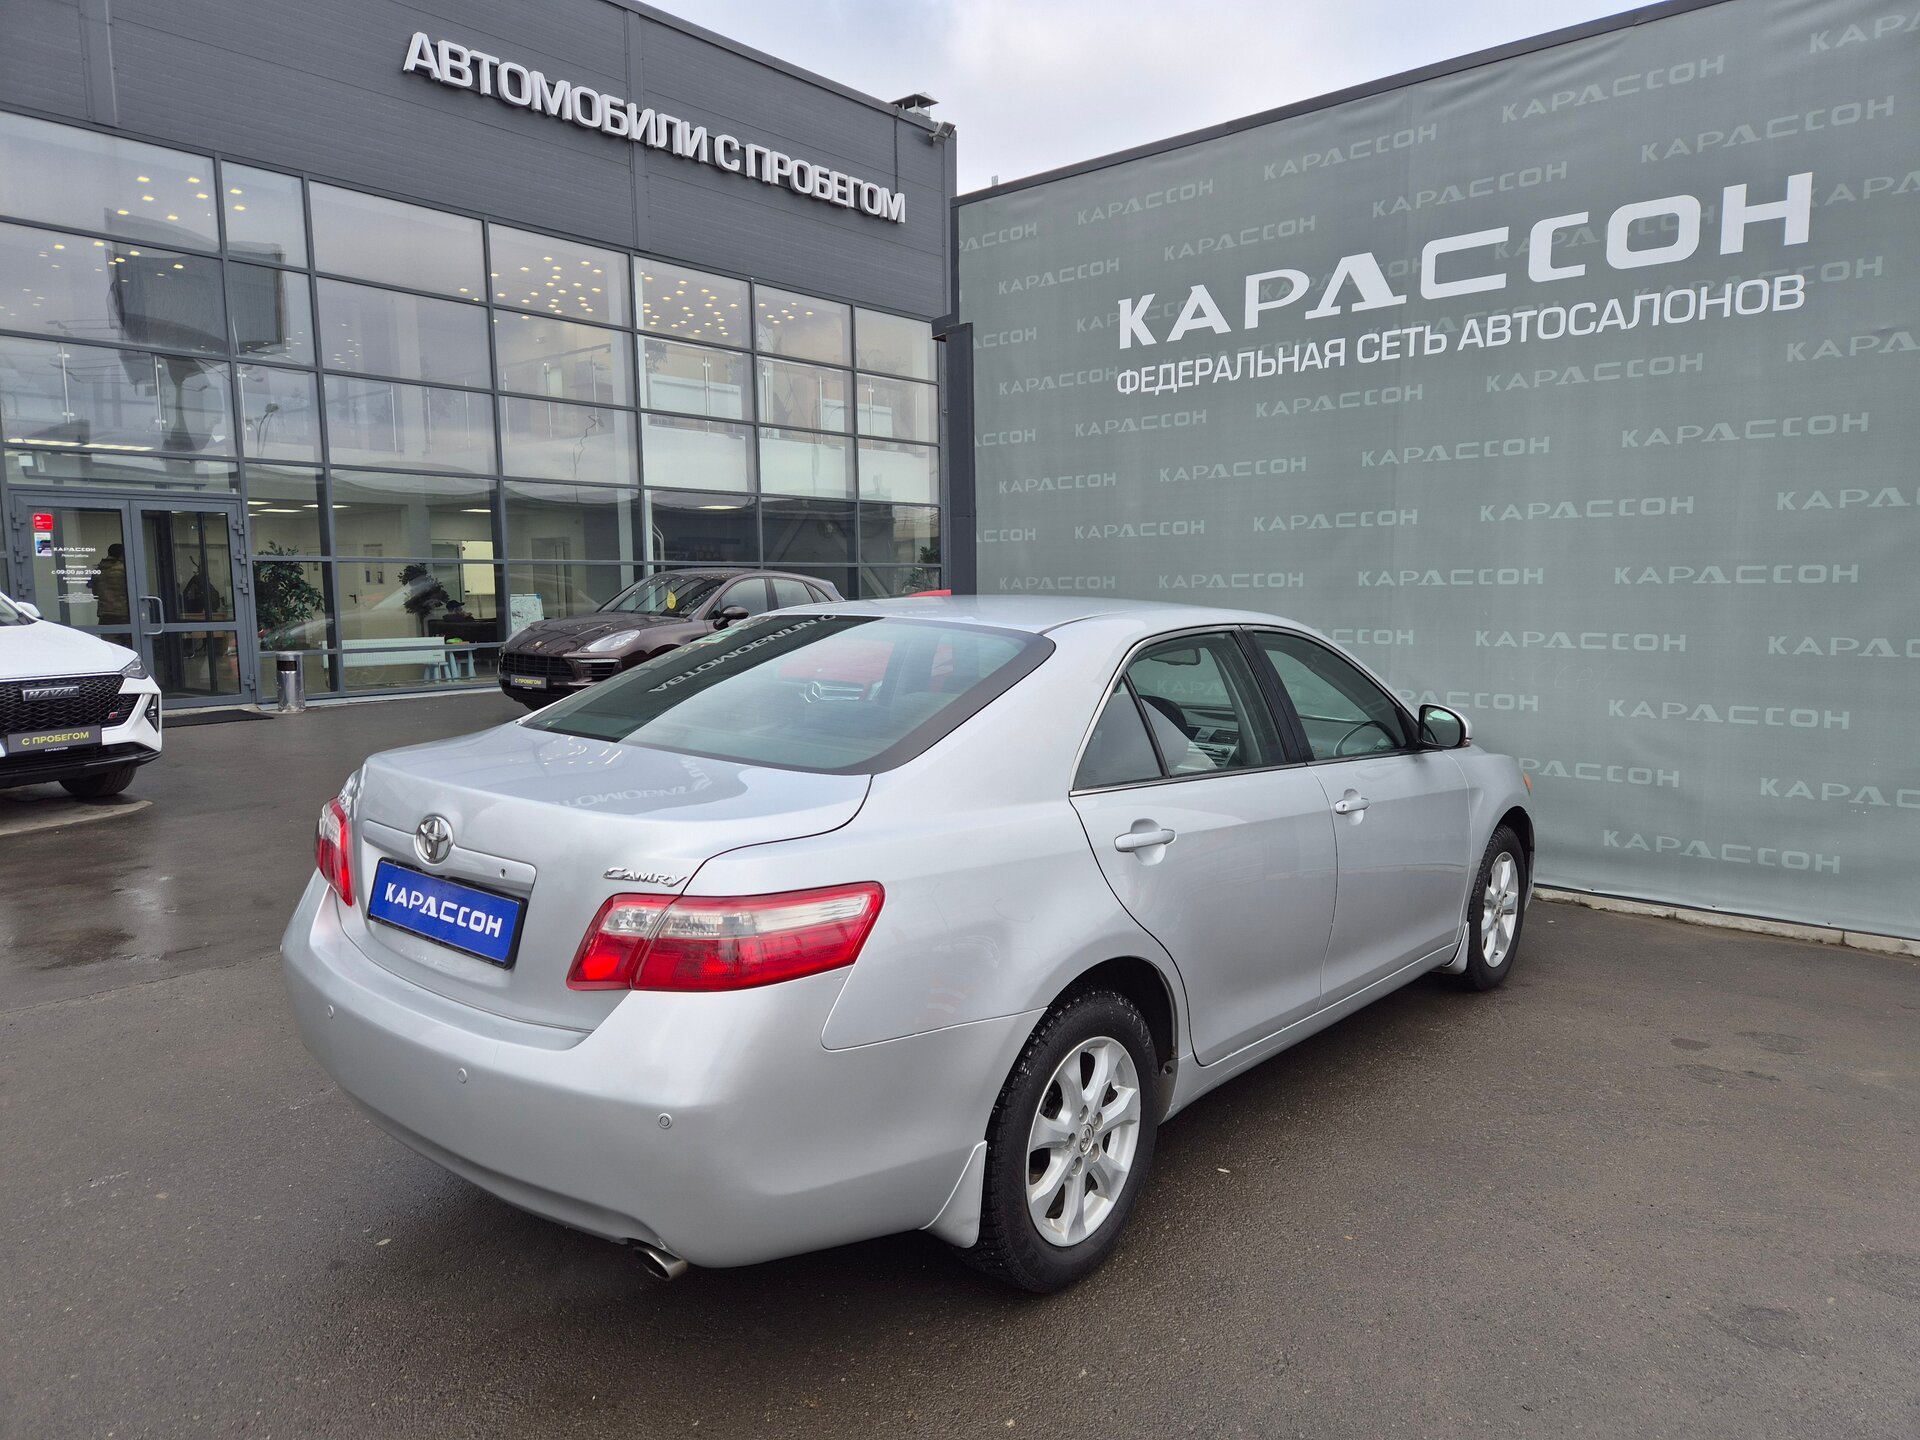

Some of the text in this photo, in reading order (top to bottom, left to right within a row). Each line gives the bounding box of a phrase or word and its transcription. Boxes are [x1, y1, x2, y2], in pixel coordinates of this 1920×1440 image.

[1502, 54, 1725, 123] КАРАССОН
[403, 31, 905, 224] АВТОМОБИЛИ С ПРОБЕГОМ
[1641, 95, 1895, 163] КАРАССОН
[1263, 123, 1437, 181] КАРАССОН
[1078, 178, 1214, 226] КАРАССОН
[1372, 160, 1567, 218] КАРАССОН
[1164, 214, 1317, 262] КАРАССОН
[999, 257, 1120, 295] КАРАССОН
[1118, 172, 1812, 349] КАРАССОН
[1117, 274, 1806, 395] ФЕДЕРАЛЬНАЯ СЕТЬ АВТОСАЛОНОВ
[1486, 353, 1703, 393] КАРАССОН
[1256, 384, 1423, 418] КАРАССОН
[1075, 409, 1207, 437] КАРАССОН
[1621, 412, 1869, 448] КАРАССОН
[1361, 436, 1551, 467] КАРАССОН
[999, 472, 1117, 494] КАРАССОН
[1159, 456, 1307, 483] КАРАССОН
[1253, 508, 1418, 532] КАРАССОН
[1480, 496, 1694, 522] КАРАССОН
[1074, 519, 1205, 540] КАРАССОН
[1000, 575, 1116, 590] КАРАССОН
[1158, 572, 1304, 589] КАРАССОН
[1357, 567, 1544, 586] КАРАССОН
[1614, 564, 1859, 585] КАРАССОН
[1475, 629, 1686, 652] КАРАССОН
[28, 688, 77, 699] HAVAL
[1608, 699, 1850, 730] КАРАССОН
[21, 731, 90, 746] С ПРОБЕГОМ
[1603, 829, 1841, 874] КАРАССОН
[385, 881, 502, 938] КАРАССОН
